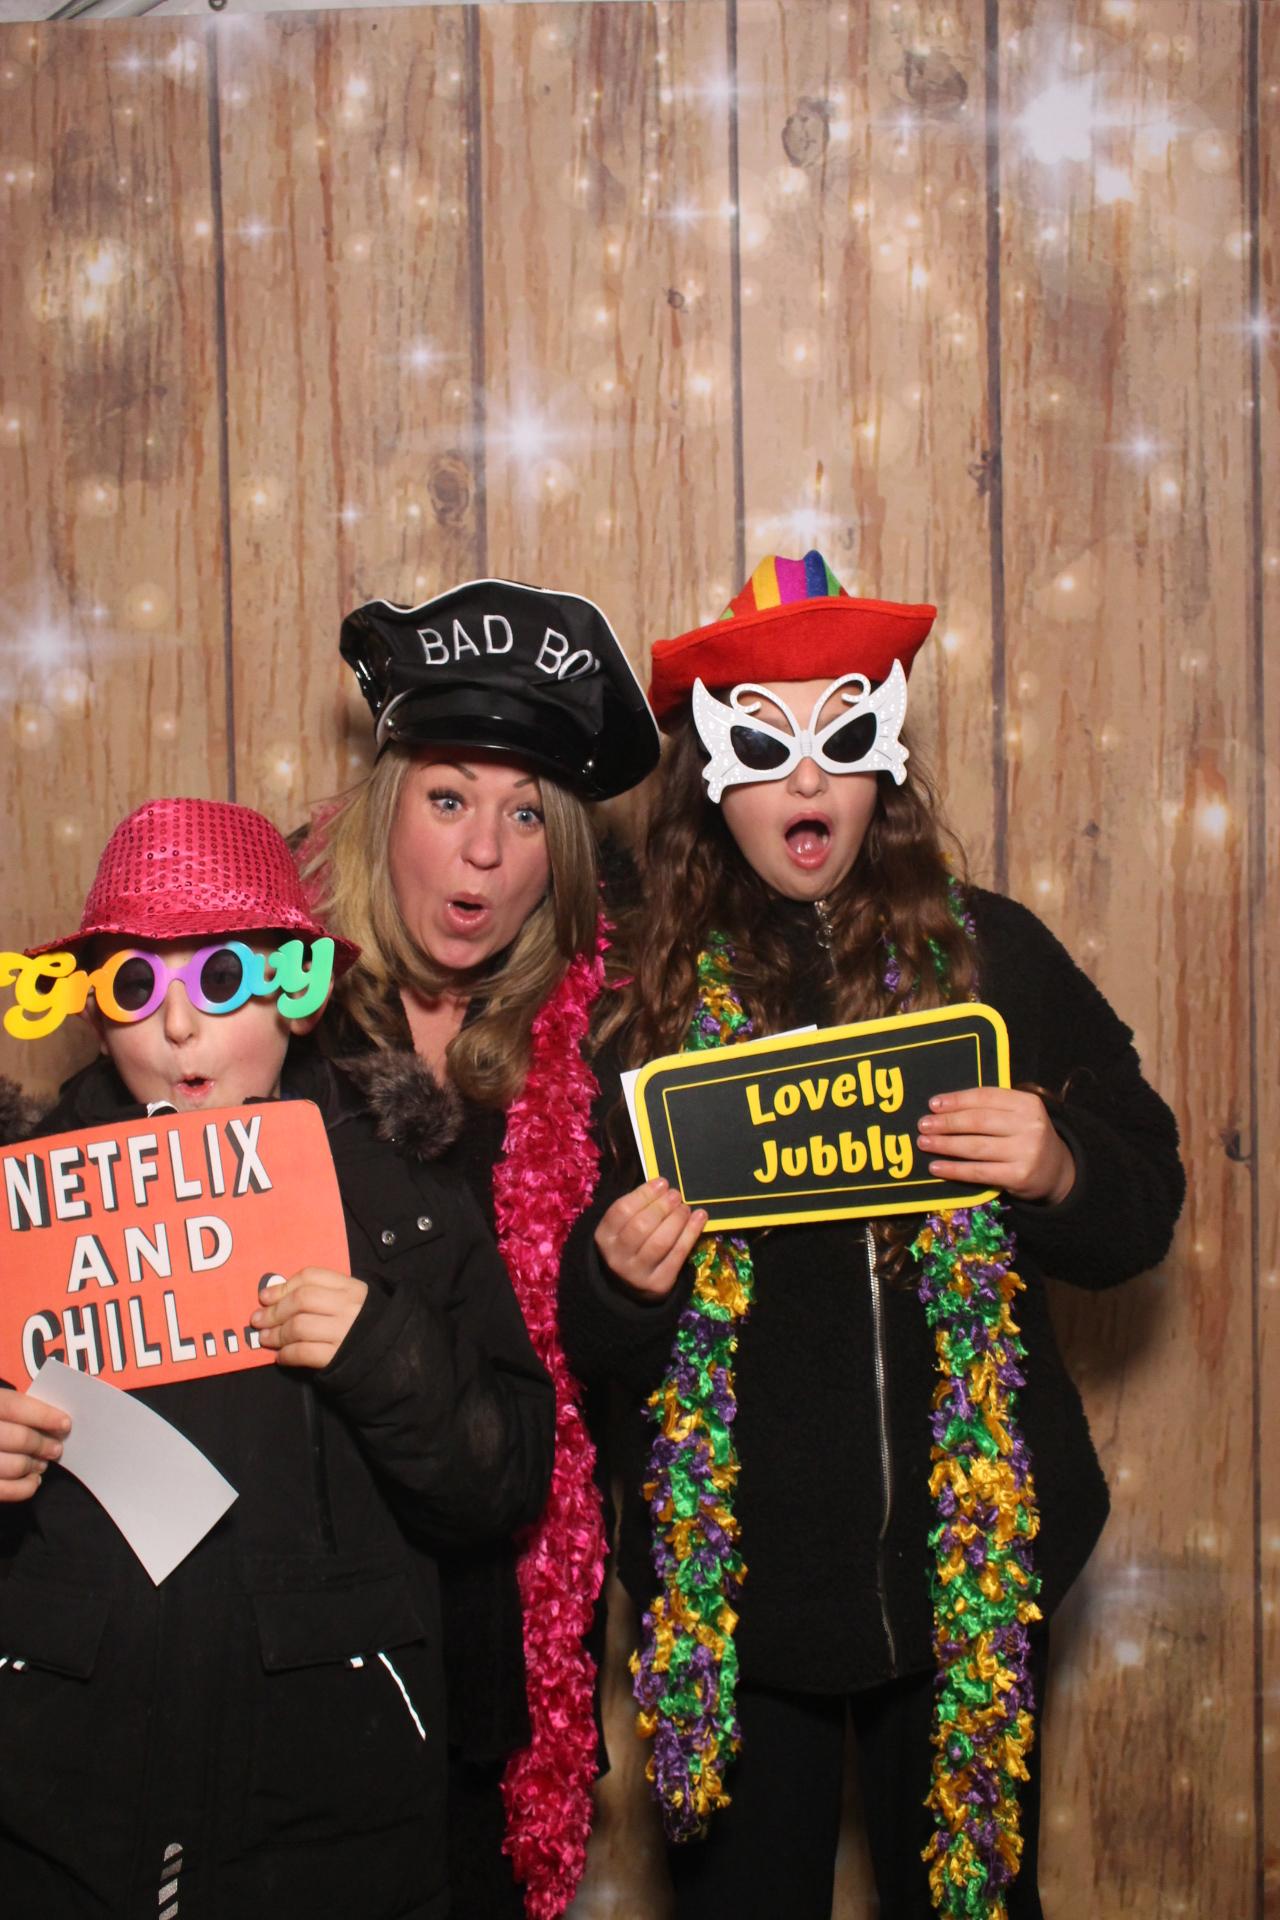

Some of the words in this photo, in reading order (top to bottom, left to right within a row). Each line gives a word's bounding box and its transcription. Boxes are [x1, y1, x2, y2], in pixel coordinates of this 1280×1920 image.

[416, 614, 513, 665] BAD
[534, 626, 600, 681] BO
[745, 1059, 905, 1126] Lovely
[2, 1115, 273, 1231] NETFLIX
[753, 1125, 914, 1184] Jubbly
[66, 1215, 234, 1293] AND
[22, 1272, 288, 1381] CHILL...
